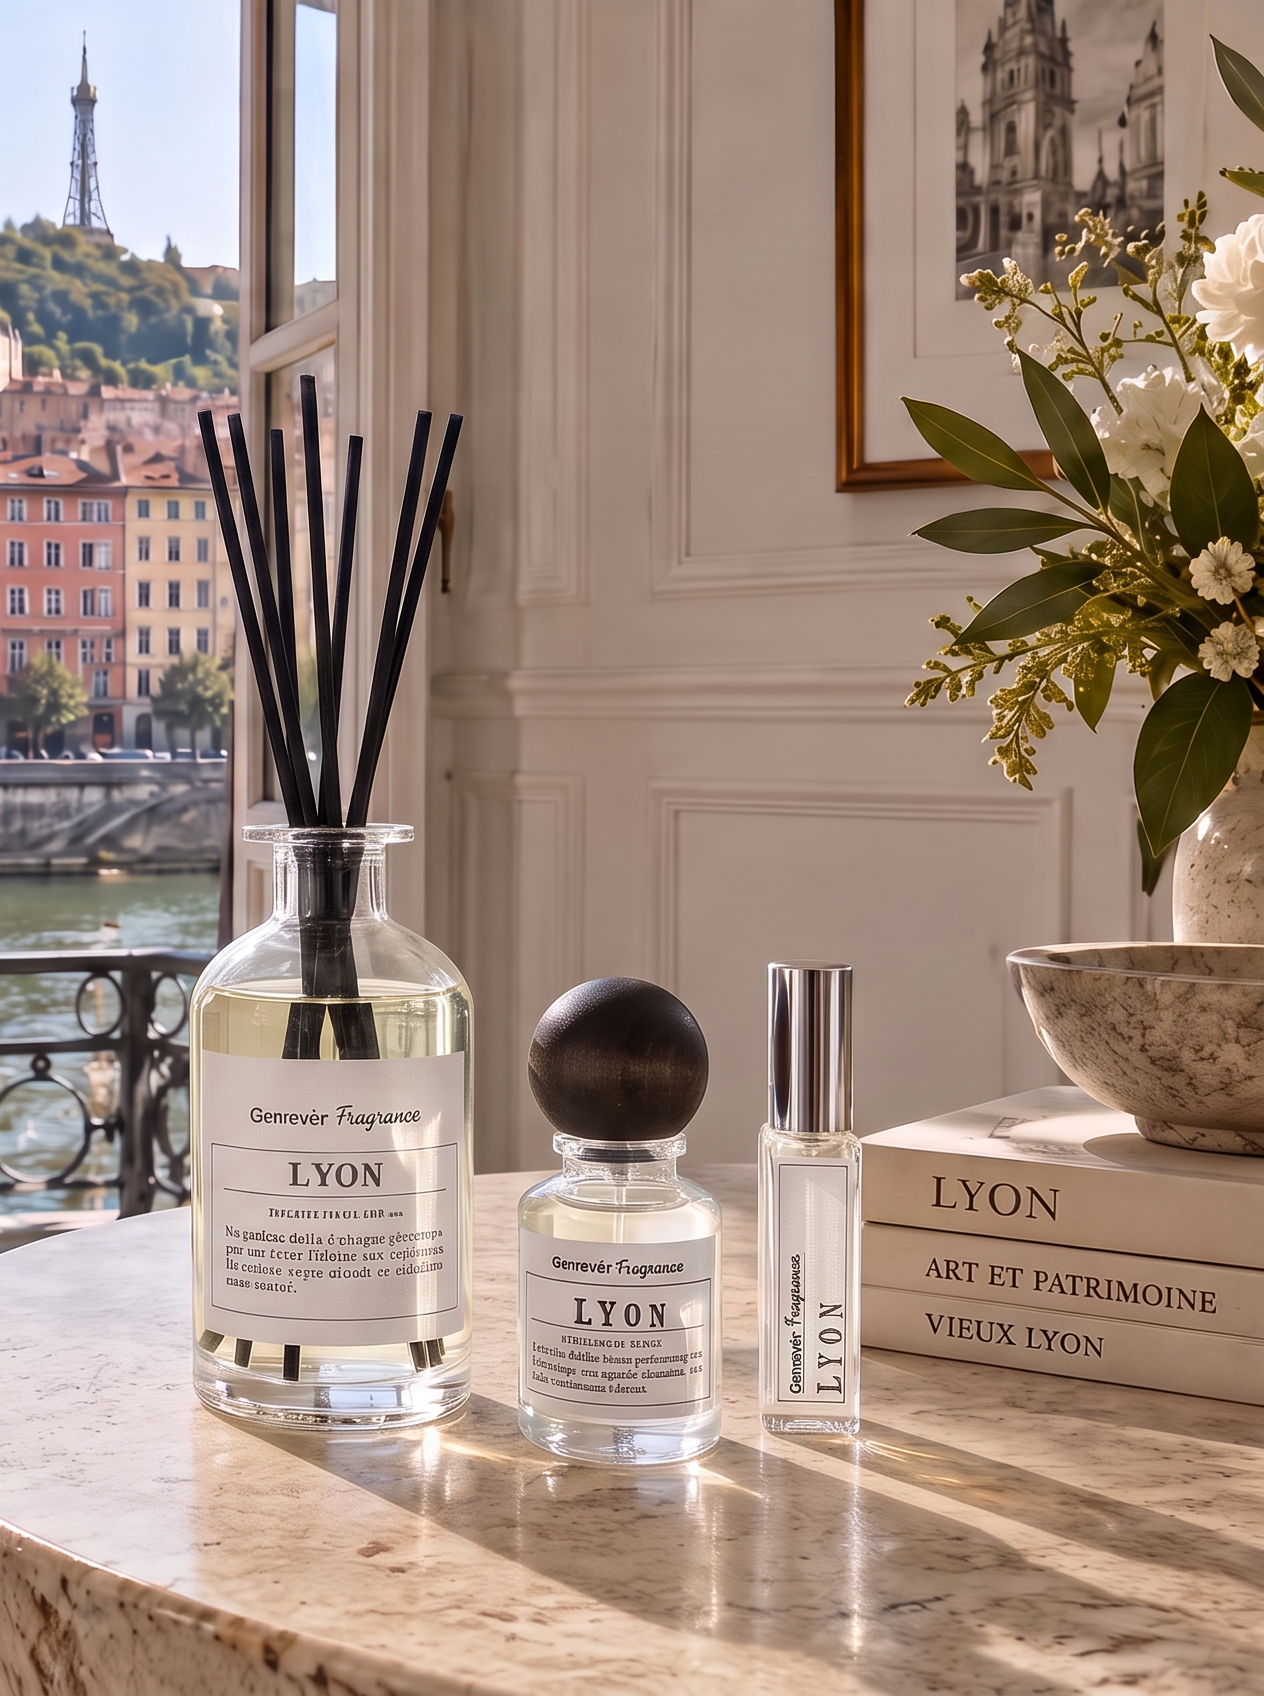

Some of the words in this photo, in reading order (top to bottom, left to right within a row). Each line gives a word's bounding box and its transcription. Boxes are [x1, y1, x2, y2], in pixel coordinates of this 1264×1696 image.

[336, 1104, 421, 1131] Fragrance
[288, 1162, 383, 1188] LYON
[931, 1175, 1060, 1222] LYON
[925, 1257, 979, 1283] ART
[989, 1265, 1023, 1288] ET
[1033, 1270, 1218, 1315] PATRIMOINE
[574, 1297, 667, 1328] LYON
[816, 1302, 843, 1395] LYON
[925, 1313, 1017, 1346] VIEUX
[1026, 1327, 1105, 1359] LYON
